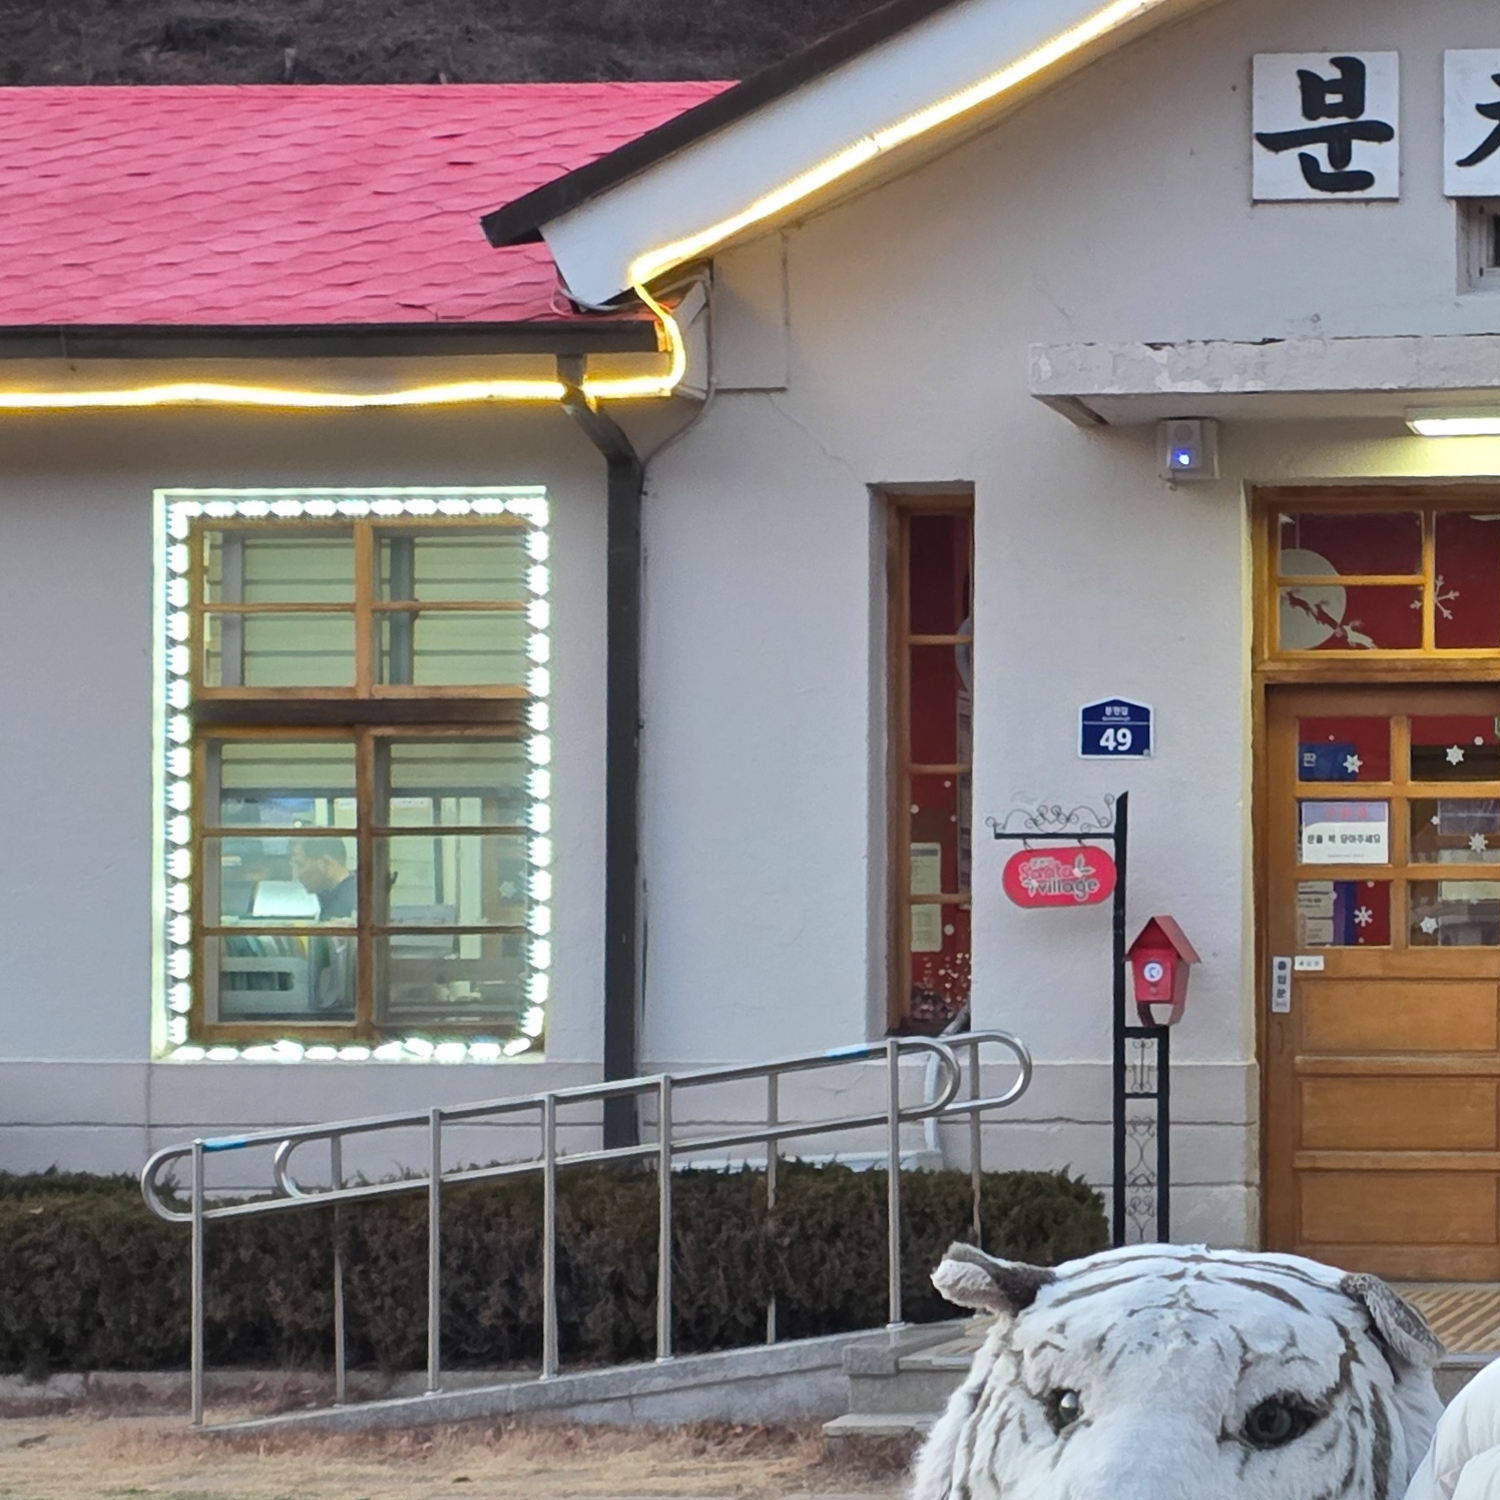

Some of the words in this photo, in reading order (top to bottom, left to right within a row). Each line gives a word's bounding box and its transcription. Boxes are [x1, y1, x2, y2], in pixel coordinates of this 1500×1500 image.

[1099, 727, 1132, 751] 49
[1019, 861, 1073, 880] Santa
[1038, 878, 1098, 901] village
